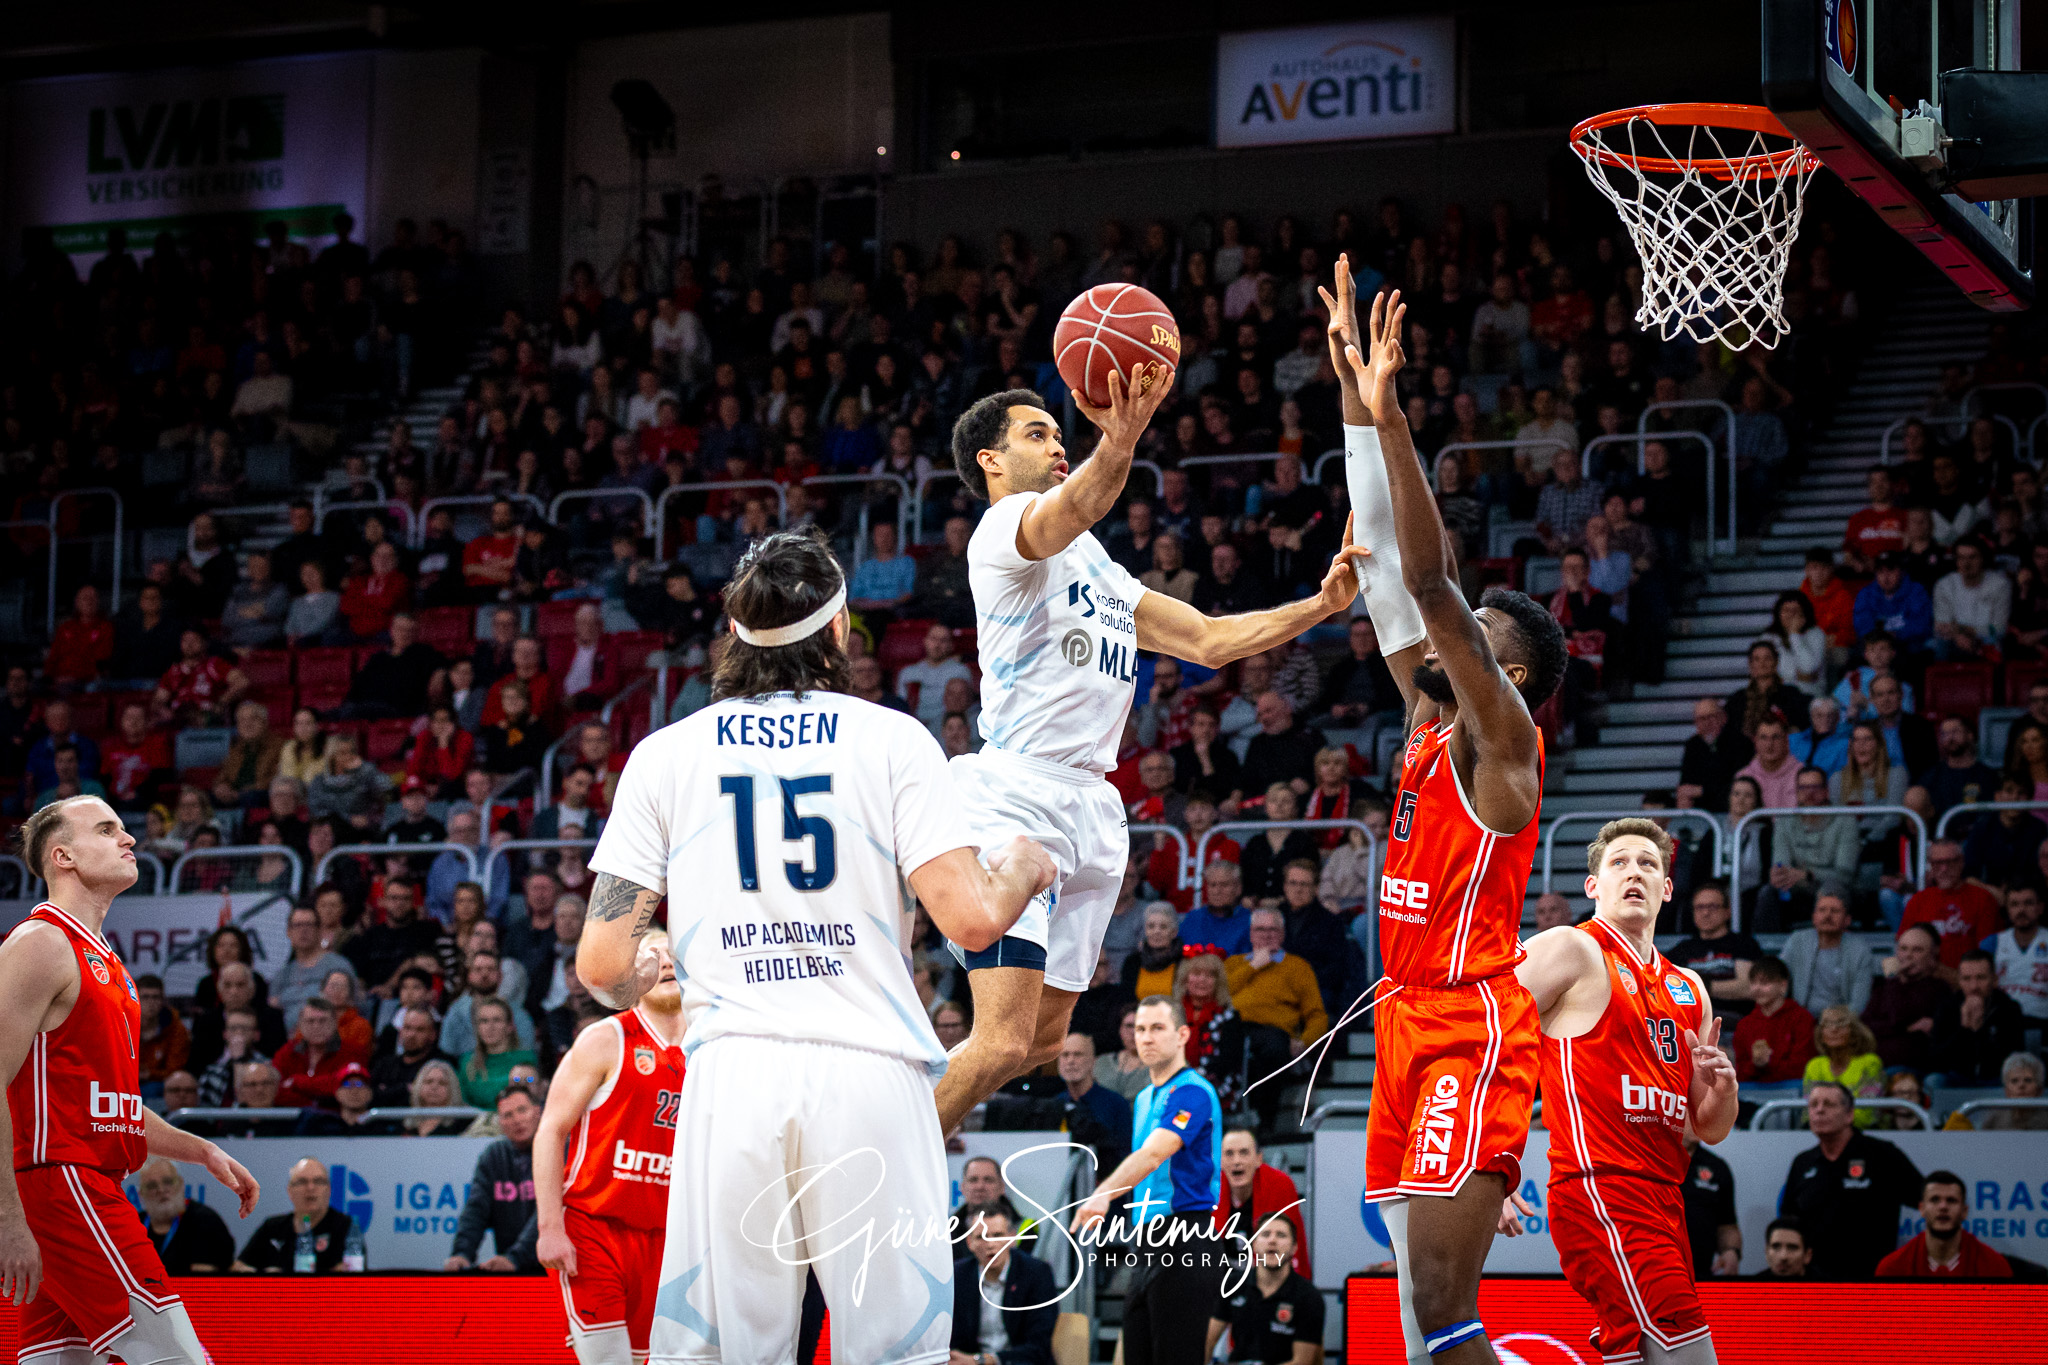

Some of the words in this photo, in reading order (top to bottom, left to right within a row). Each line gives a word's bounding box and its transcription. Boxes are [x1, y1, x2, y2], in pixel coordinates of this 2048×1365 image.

[1240, 57, 1422, 124] Aventi
[87, 97, 222, 175] LVM
[86, 166, 284, 204] VERSICHERUNG
[717, 713, 839, 749] KESSEN
[718, 772, 839, 893] 15
[1393, 790, 1419, 842] 5
[721, 923, 758, 950] MLP
[762, 921, 857, 947] ACADEMICS
[652, 1088, 683, 1131] 22
